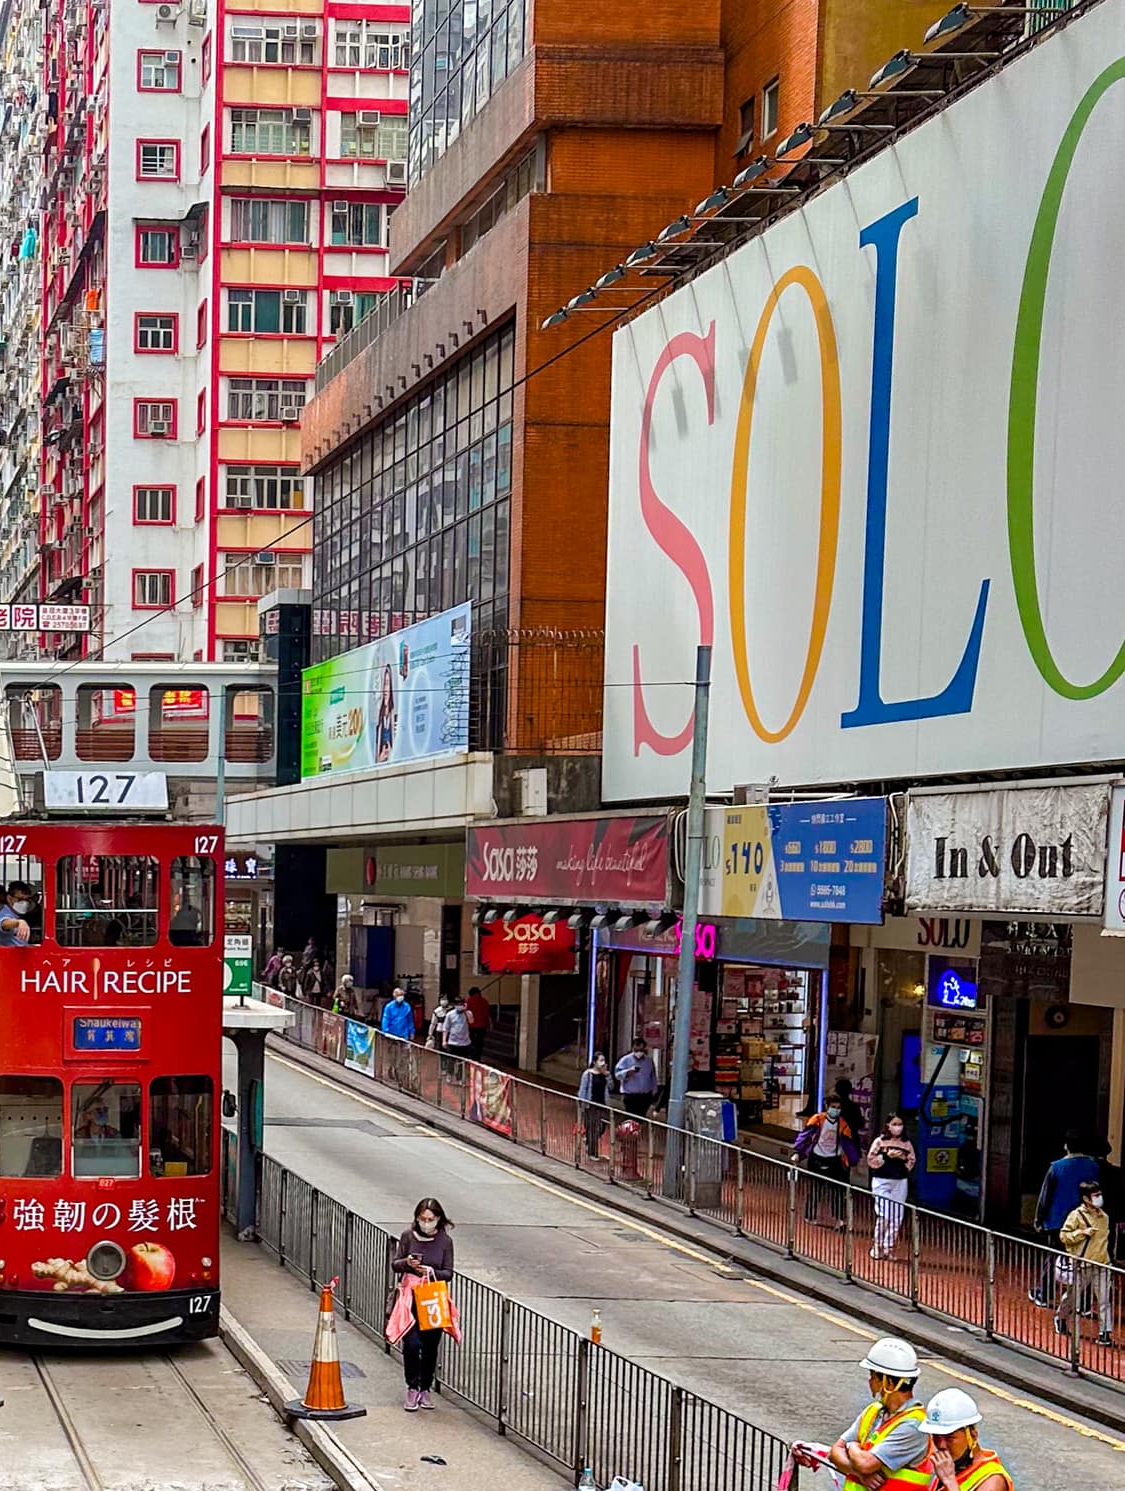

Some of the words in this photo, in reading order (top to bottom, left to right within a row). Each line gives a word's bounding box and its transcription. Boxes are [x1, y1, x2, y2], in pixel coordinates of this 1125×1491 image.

[633, 56, 1125, 757] SOLO
[76, 775, 136, 804] 127
[0, 835, 27, 853] 127
[194, 836, 219, 854] 127
[934, 836, 968, 879] In
[979, 835, 1000, 878] &
[1011, 832, 1075, 879] Out
[483, 842, 513, 881] Sasa
[515, 846, 538, 881] 莎莎
[586, 843, 604, 886] life
[42, 958, 71, 967] ヘア
[127, 957, 174, 968] レシピ
[21, 970, 90, 994] HAIR
[103, 970, 192, 994] RECIPE
[13, 1197, 198, 1233] 強韌の髮根
[189, 1295, 211, 1314] 127
[420, 1291, 444, 1328] csl.
